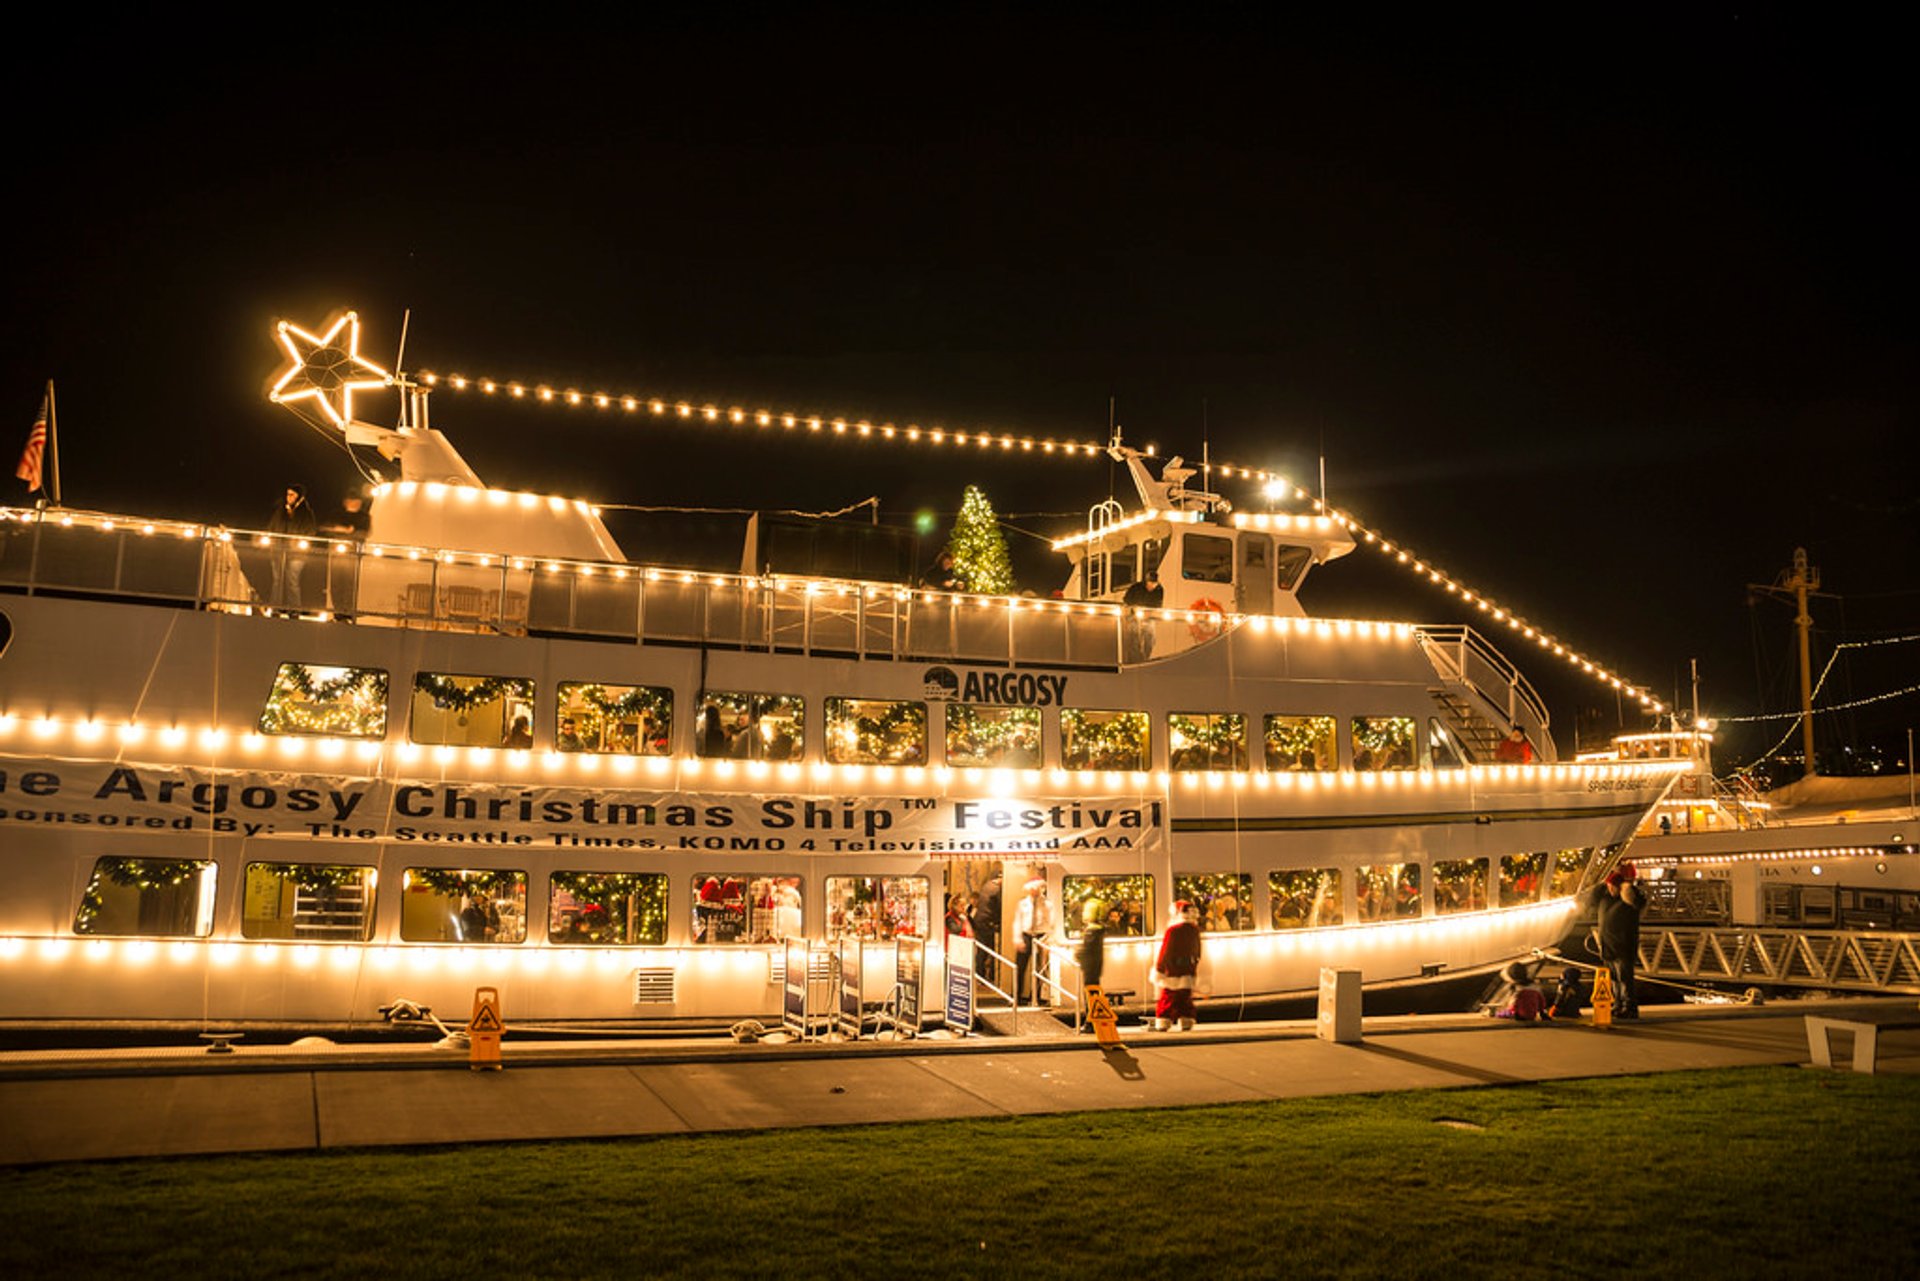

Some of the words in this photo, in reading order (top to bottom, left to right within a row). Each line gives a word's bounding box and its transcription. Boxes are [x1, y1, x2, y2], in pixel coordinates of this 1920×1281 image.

[962, 671, 1068, 706] ARGOSY
[0, 770, 60, 796] e
[94, 767, 364, 821] Argosy
[395, 786, 734, 827] Christmas
[954, 802, 1162, 829] Festival
[213, 817, 275, 836] By:
[304, 823, 377, 838] The
[395, 827, 533, 844] Seattle
[548, 833, 666, 850] Times,
[679, 836, 785, 850] KOMO
[800, 839, 816, 851] 4
[829, 838, 994, 852] Television
[1008, 838, 1060, 850] and
[1072, 836, 1133, 849] AAA
